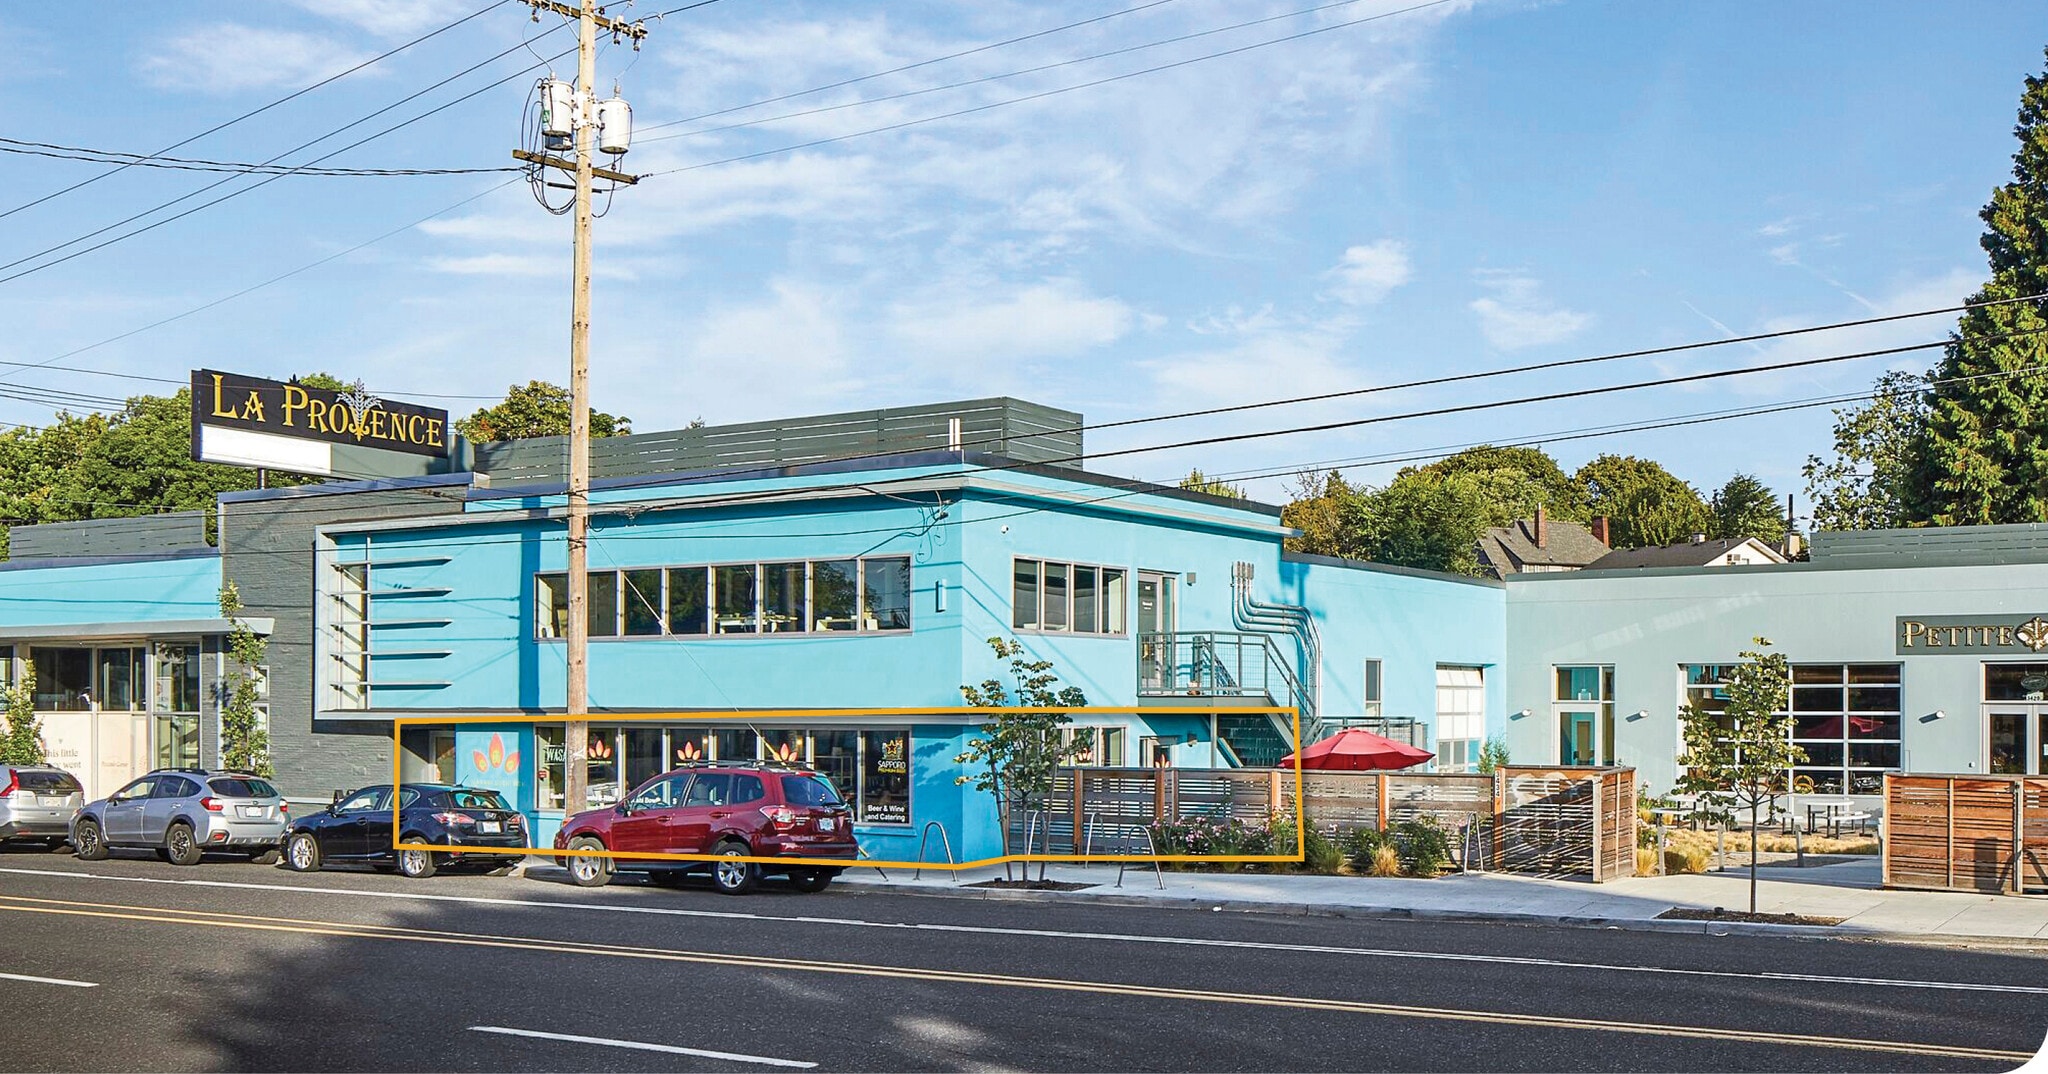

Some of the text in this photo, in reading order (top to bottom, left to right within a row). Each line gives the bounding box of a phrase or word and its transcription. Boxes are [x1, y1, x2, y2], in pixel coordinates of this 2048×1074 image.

[211, 373, 443, 447] LA PROVENCE
[1901, 620, 2015, 647] PETITE
[60, 748, 79, 758] little
[878, 760, 906, 769] SAPPORO
[867, 804, 905, 813] Beer & Wine
[880, 813, 906, 823] Catering
